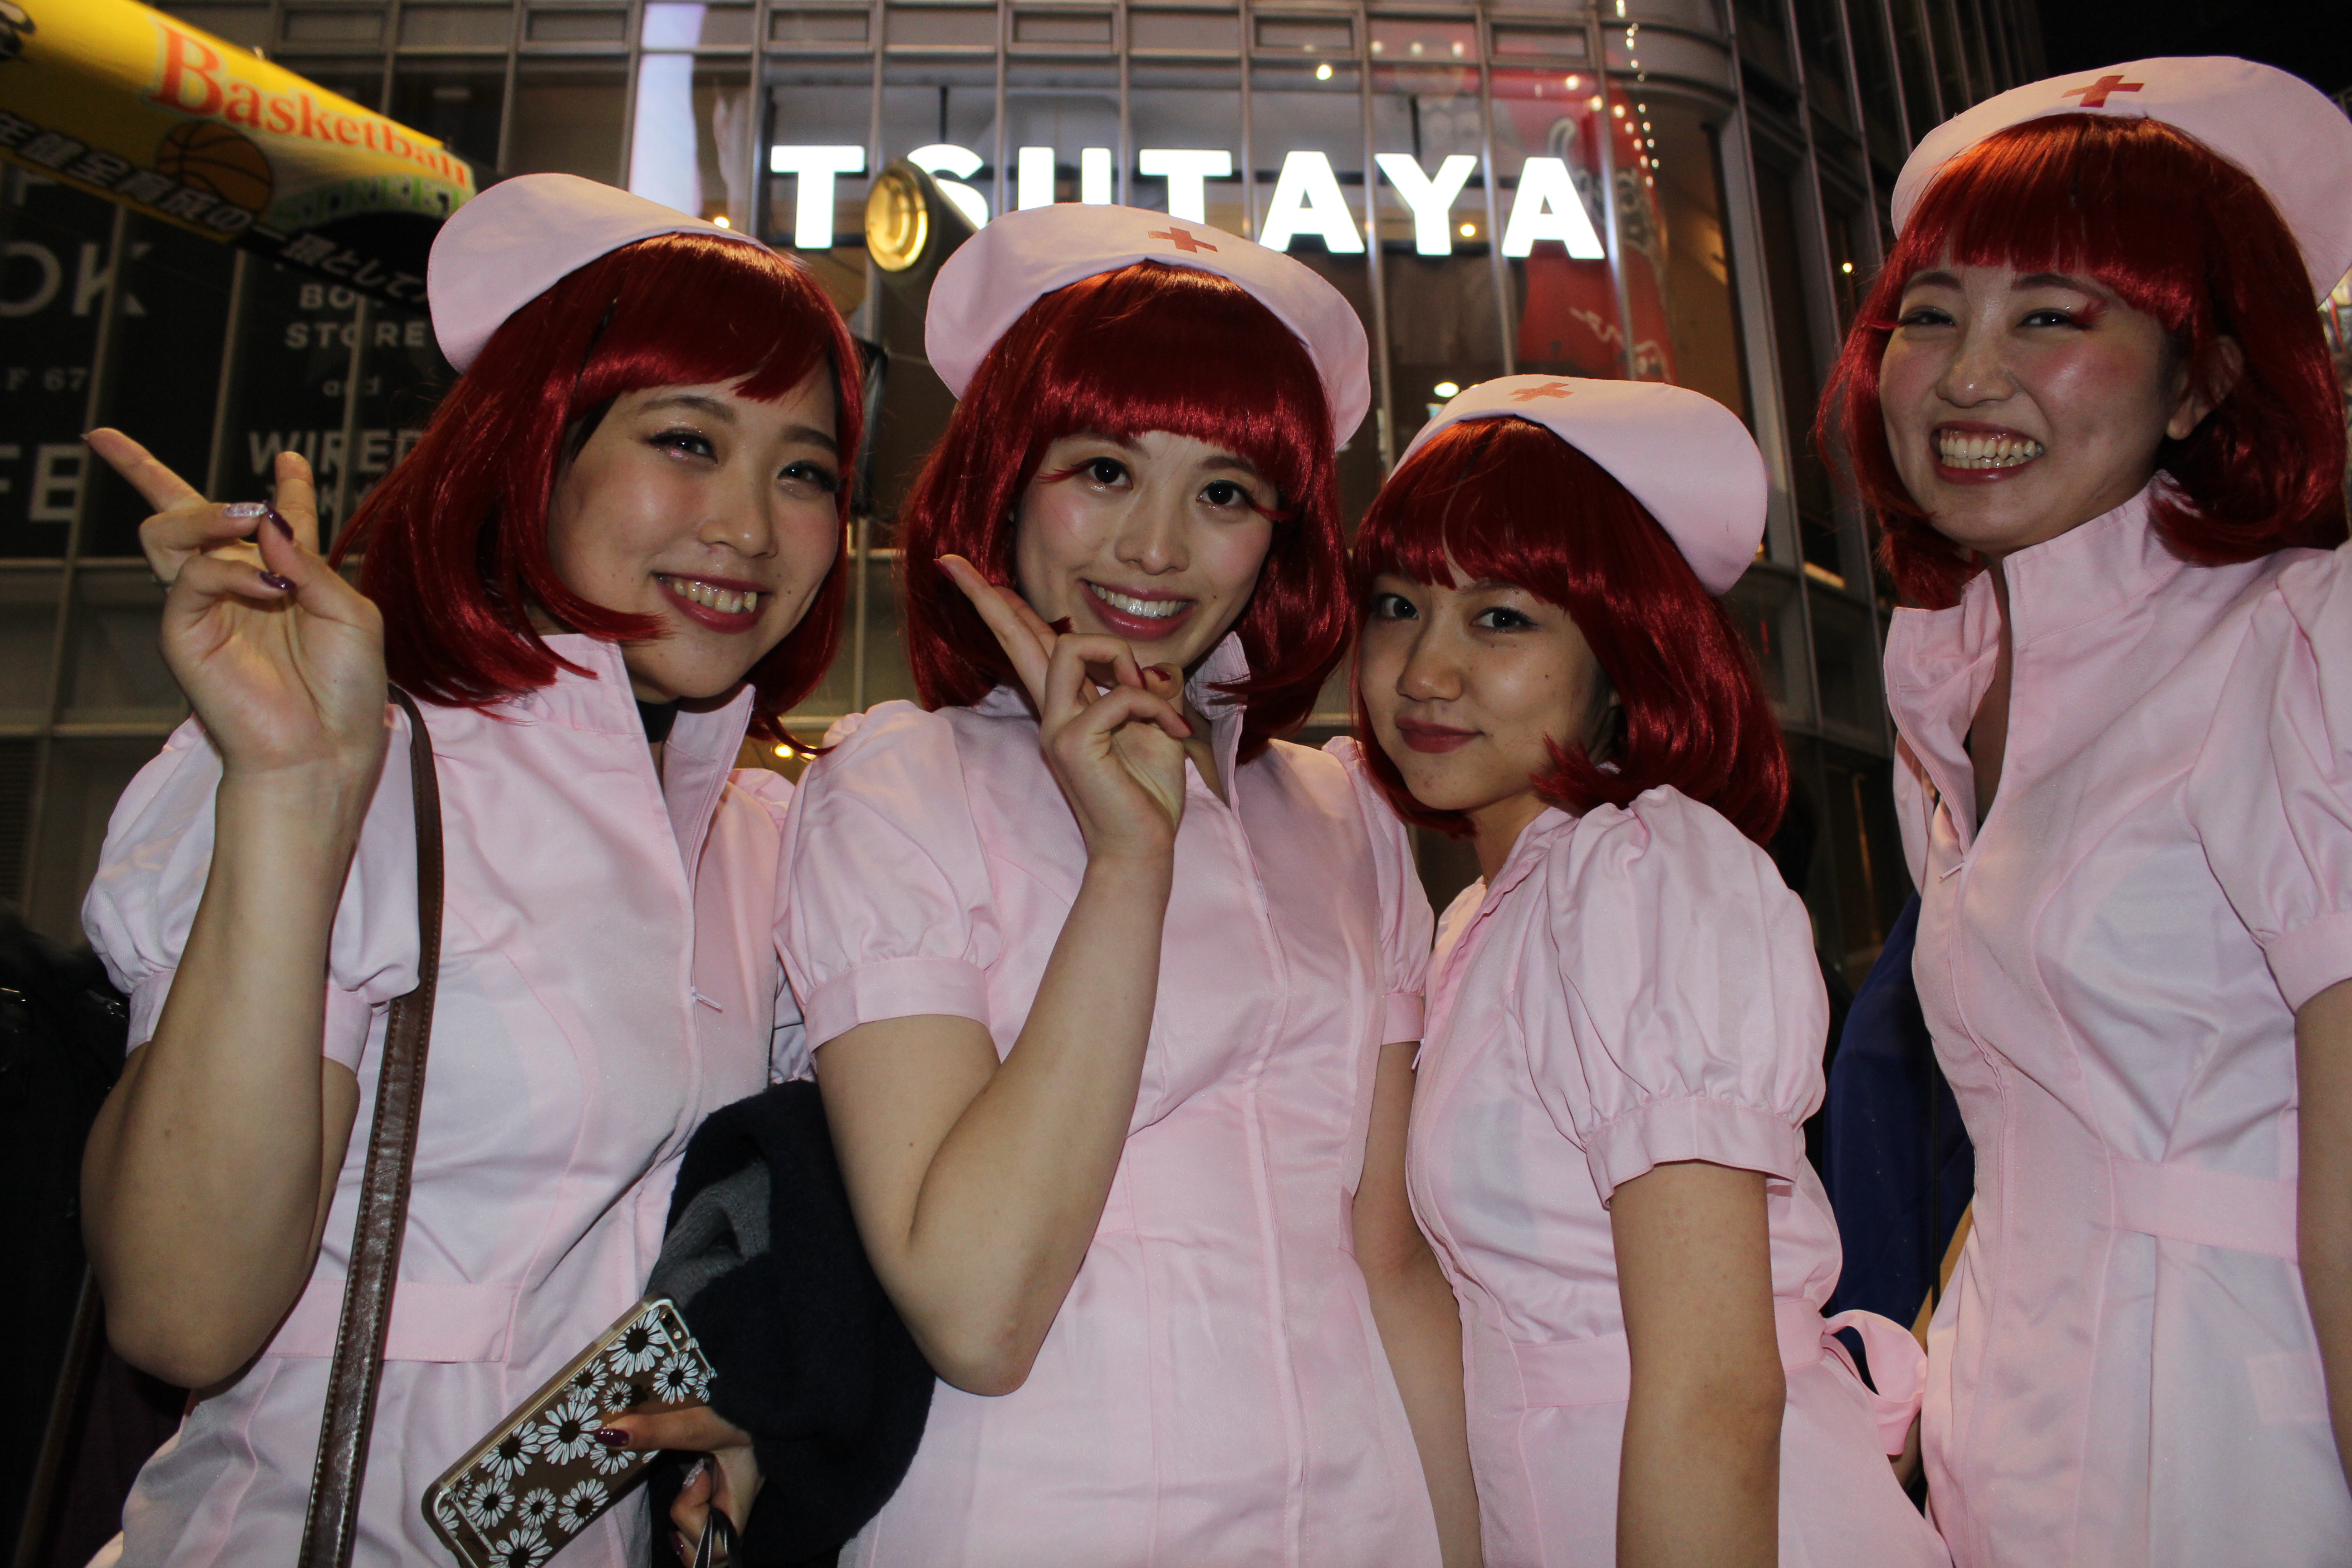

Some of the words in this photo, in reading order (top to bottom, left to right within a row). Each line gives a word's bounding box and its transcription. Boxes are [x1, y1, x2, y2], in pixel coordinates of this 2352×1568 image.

[148, 20, 466, 187] Basketball
[770, 142, 1606, 260] TSUTAYA
[299, 282, 388, 309] BO
[43, 366, 87, 392] 67
[321, 374, 381, 397] ad
